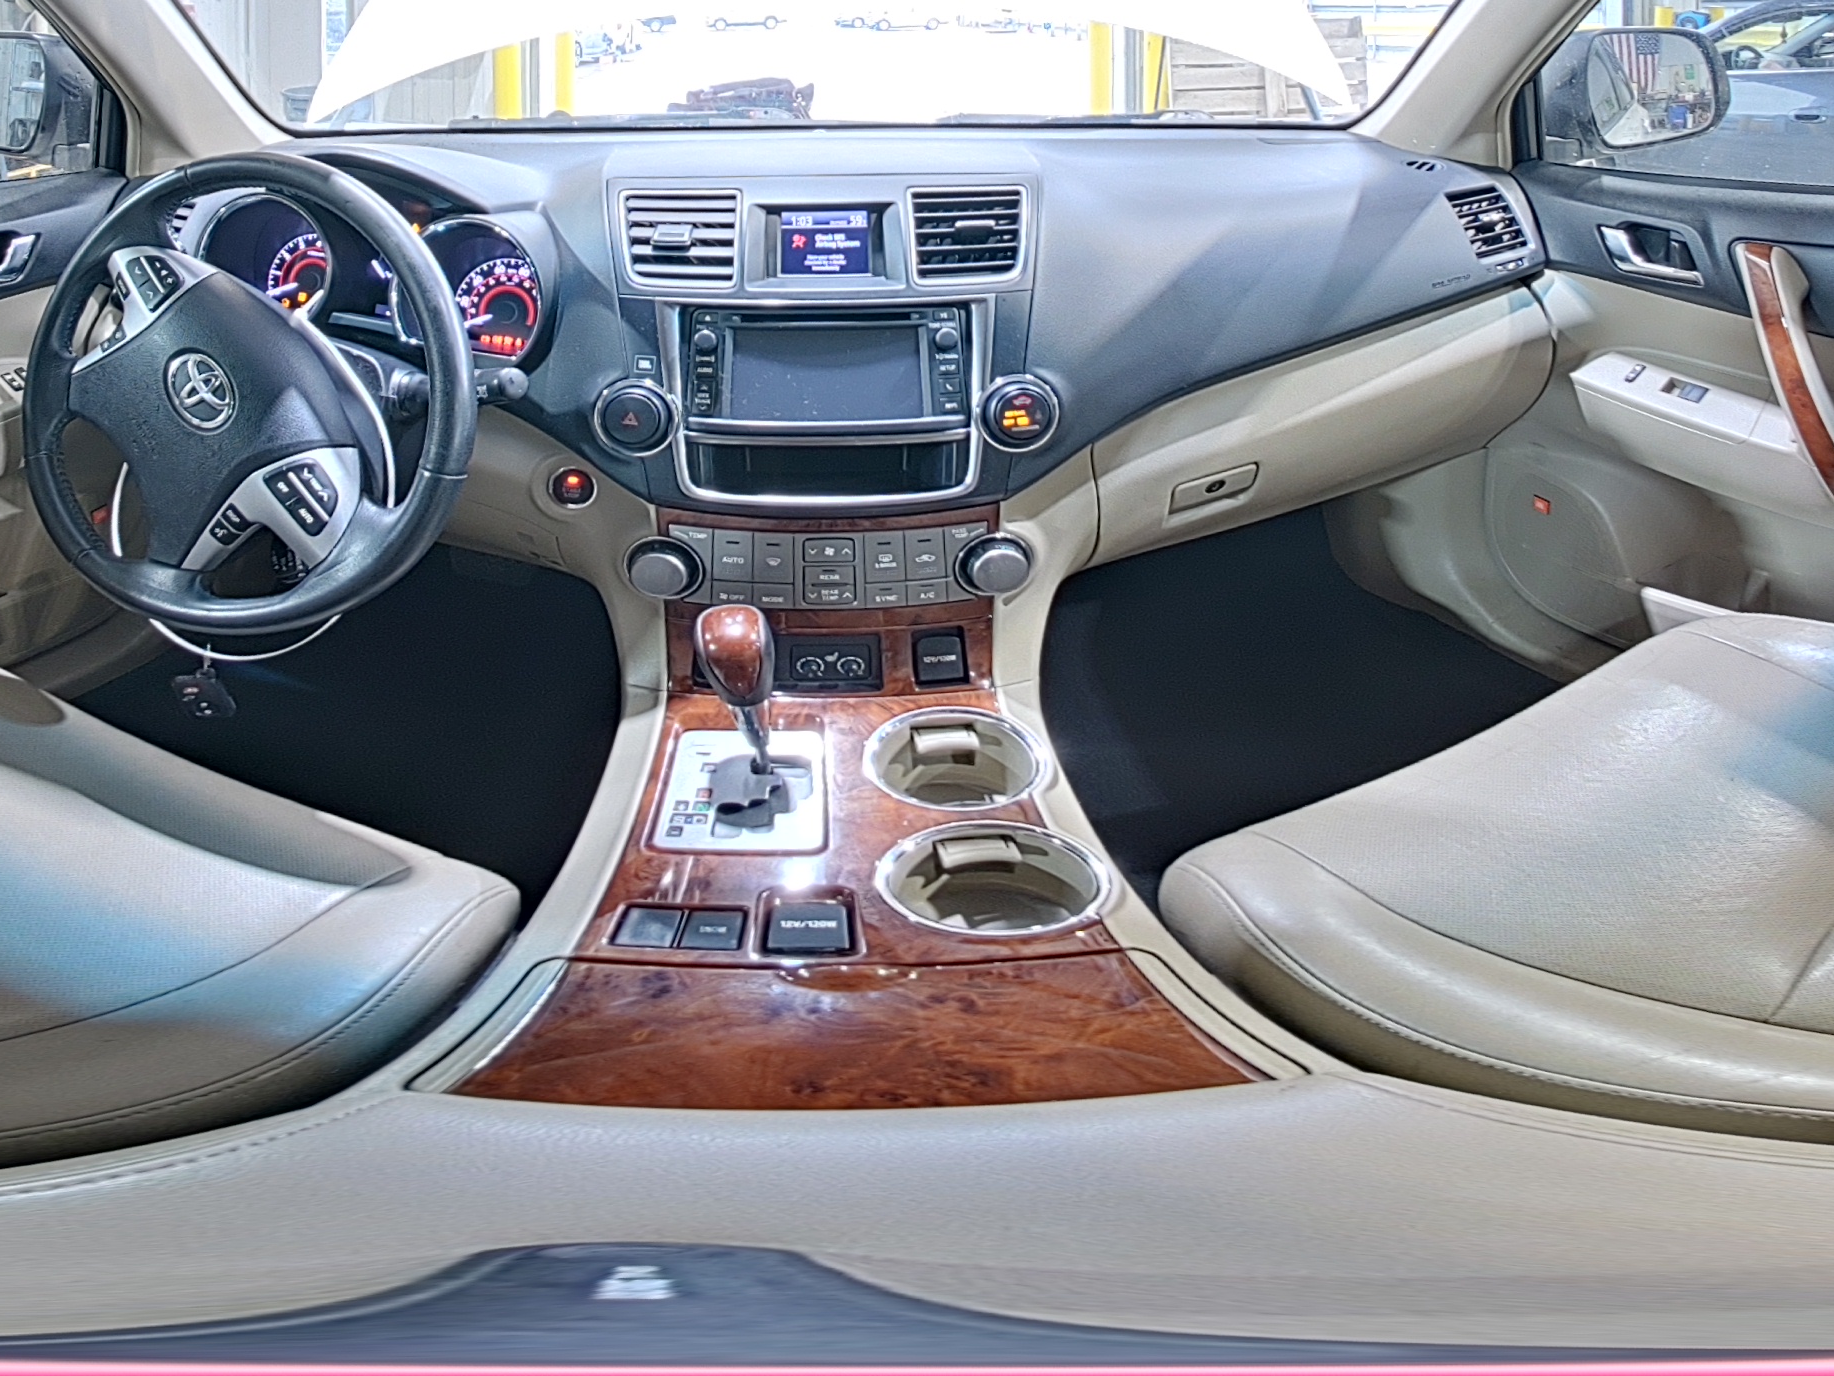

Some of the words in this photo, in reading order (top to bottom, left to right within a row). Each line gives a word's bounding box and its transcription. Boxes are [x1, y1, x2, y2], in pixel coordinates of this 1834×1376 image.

[791, 215, 813, 227] 1:03
[850, 215, 863, 226] 59
[721, 556, 744, 565] AUTO
